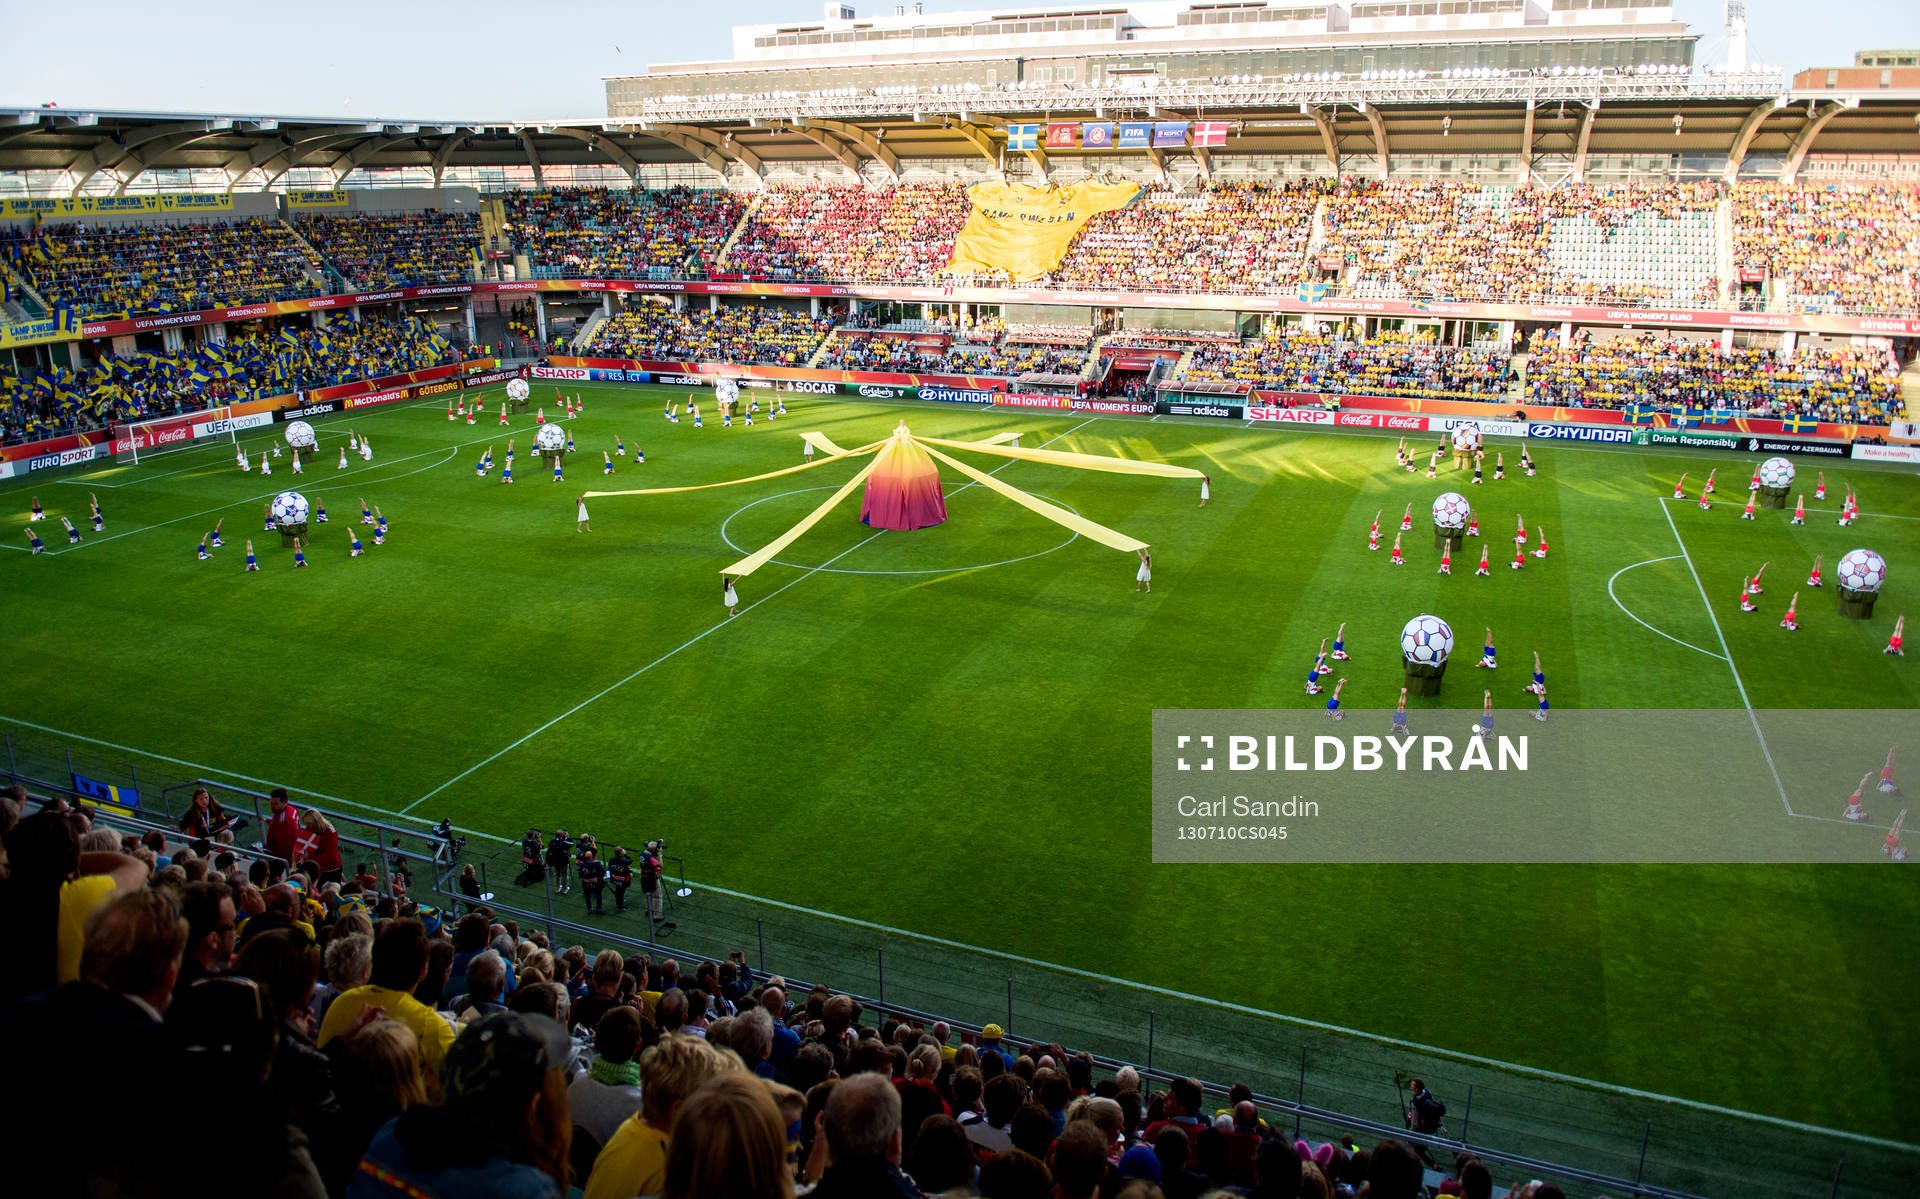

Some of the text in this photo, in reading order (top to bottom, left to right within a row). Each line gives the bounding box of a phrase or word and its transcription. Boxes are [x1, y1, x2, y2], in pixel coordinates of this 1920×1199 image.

[1125, 128, 1144, 137] FIFA
[417, 288, 430, 296] UEFA
[136, 320, 154, 329] UEFA
[183, 314, 201, 323] EURO
[1607, 311, 1693, 322] UEFA WOMEN'S EURO
[466, 370, 519, 387] UEFA WOMEN'S EURO
[536, 368, 586, 379] SHARP
[608, 372, 641, 382] RESECT
[676, 376, 703, 386] adidas
[419, 380, 459, 396] GÖTEBORG
[796, 381, 837, 395] SOCAR
[859, 385, 894, 398] Carlsberg
[354, 391, 401, 407] McDonald's
[938, 391, 993, 404] HYUNDAI
[304, 403, 334, 416] adidas
[1070, 401, 1091, 410] UEFA
[1092, 402, 1130, 412] WOMEN'S
[1193, 407, 1229, 417] adidas
[1250, 407, 1328, 423] SHARP
[206, 415, 261, 434] UEFA.com
[1557, 428, 1632, 443] HYUNDAI
[1653, 434, 1737, 449] Drink Responsibly
[1763, 443, 1790, 451] ENERGY
[31, 448, 94, 471] EUROSPORT
[1864, 449, 1882, 457] Make
[1888, 450, 1912, 459] healthy
